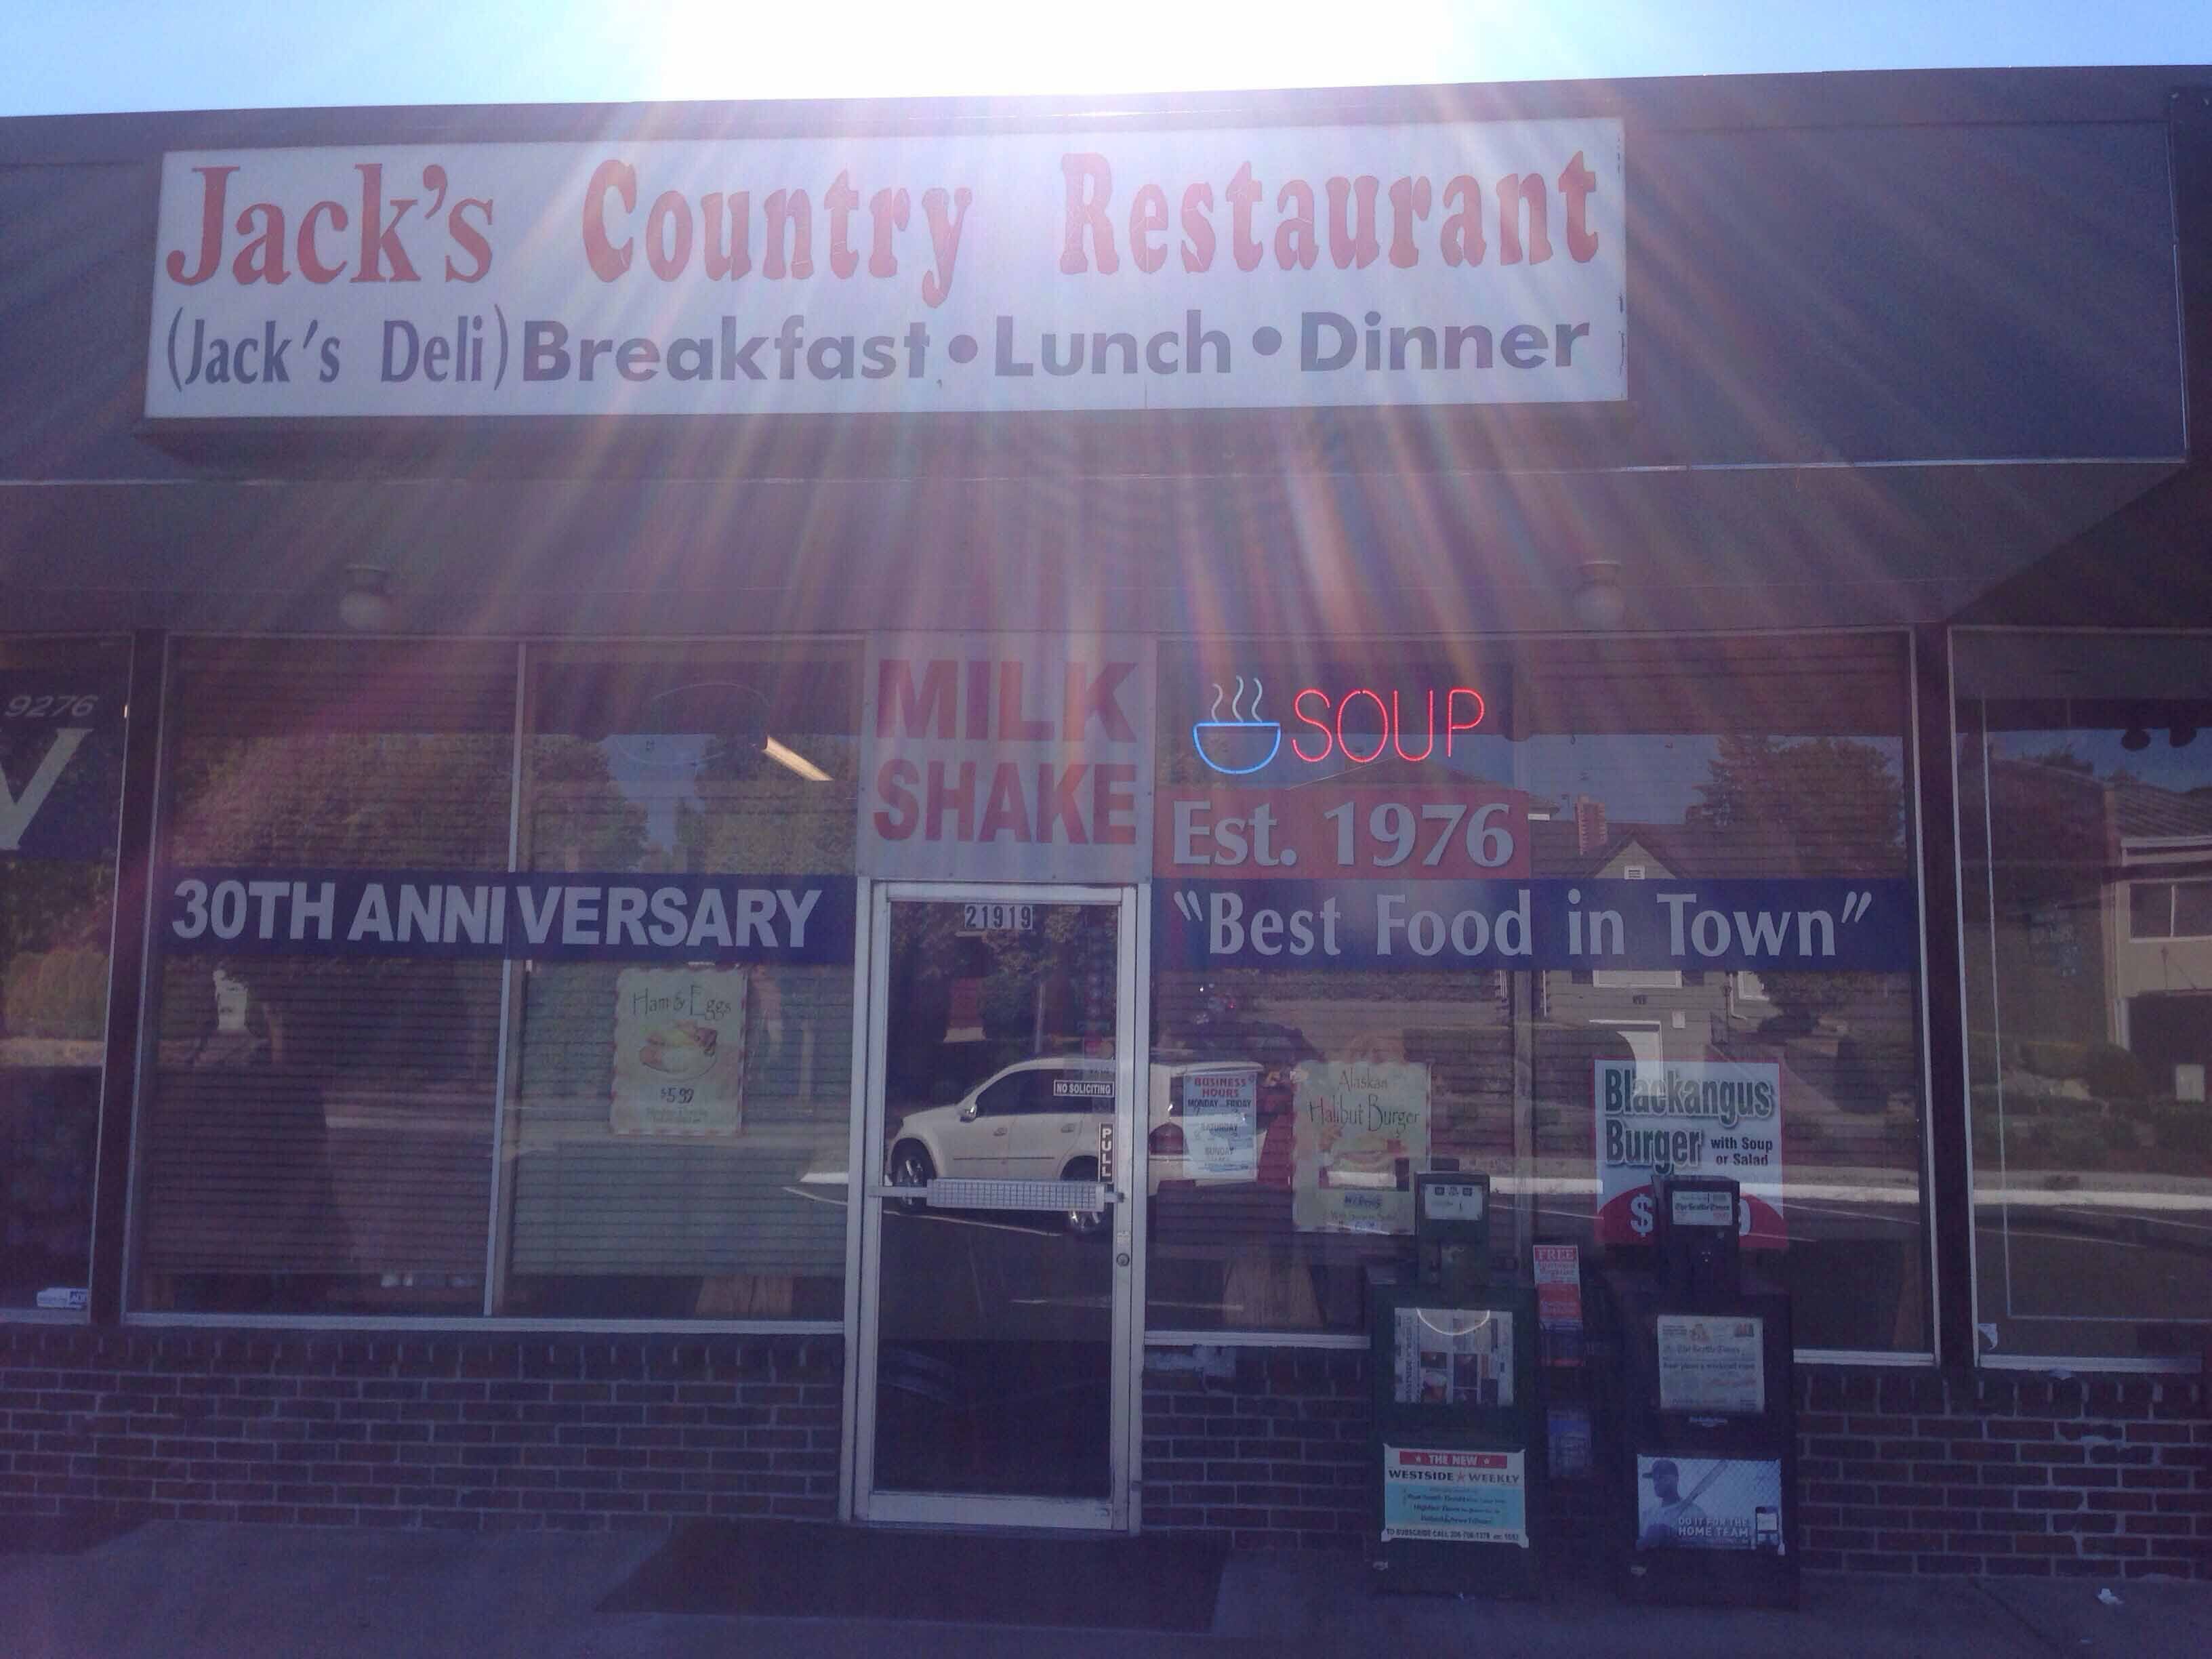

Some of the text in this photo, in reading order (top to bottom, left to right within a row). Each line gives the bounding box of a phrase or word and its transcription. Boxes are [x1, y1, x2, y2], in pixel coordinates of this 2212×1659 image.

[167, 150, 1599, 309] Jack's Country Restaurant
[380, 303, 509, 391] Deli)
[523, 313, 930, 382] Breakfast
[994, 309, 1232, 377] Lunch
[1300, 311, 1590, 372] Dinner
[3, 694, 100, 719] 9276
[876, 658, 1139, 743] MILK
[1291, 688, 1486, 763] SOUP
[873, 758, 1139, 845] SHAKE
[1172, 800, 1515, 868] Est. 1976
[171, 879, 822, 949] 30TH ANNIVERSARY
[964, 904, 1032, 928] 21919
[1375, 888, 1534, 958] Food
[1567, 888, 1625, 955] in
[632, 987, 670, 1016] Ham
[689, 984, 732, 1021] Eggs
[1056, 1084, 1111, 1094] NO SOLICITING
[1194, 1077, 1247, 1088] BUSINESS
[1202, 1088, 1240, 1099] HOURS
[1604, 1068, 1775, 1128] Blackangus
[1187, 1099, 1252, 1109] MONDAY FRIDAY
[1307, 1094, 1421, 1138] Halibut Burger
[1101, 1128, 1113, 1178] PULL
[1604, 1118, 1704, 1175] Burger
[1711, 1136, 1773, 1153] with Soup
[1715, 1153, 1769, 1166] or Salad
[1538, 1248, 1574, 1260] FREE
[1428, 1453, 1478, 1466] THE NEW
[1388, 1469, 1520, 1484] WESTSIDE WEEKLY
[1678, 1526, 1748, 1537] HOME TEAM
[1679, 1517, 1692, 1525] DO
